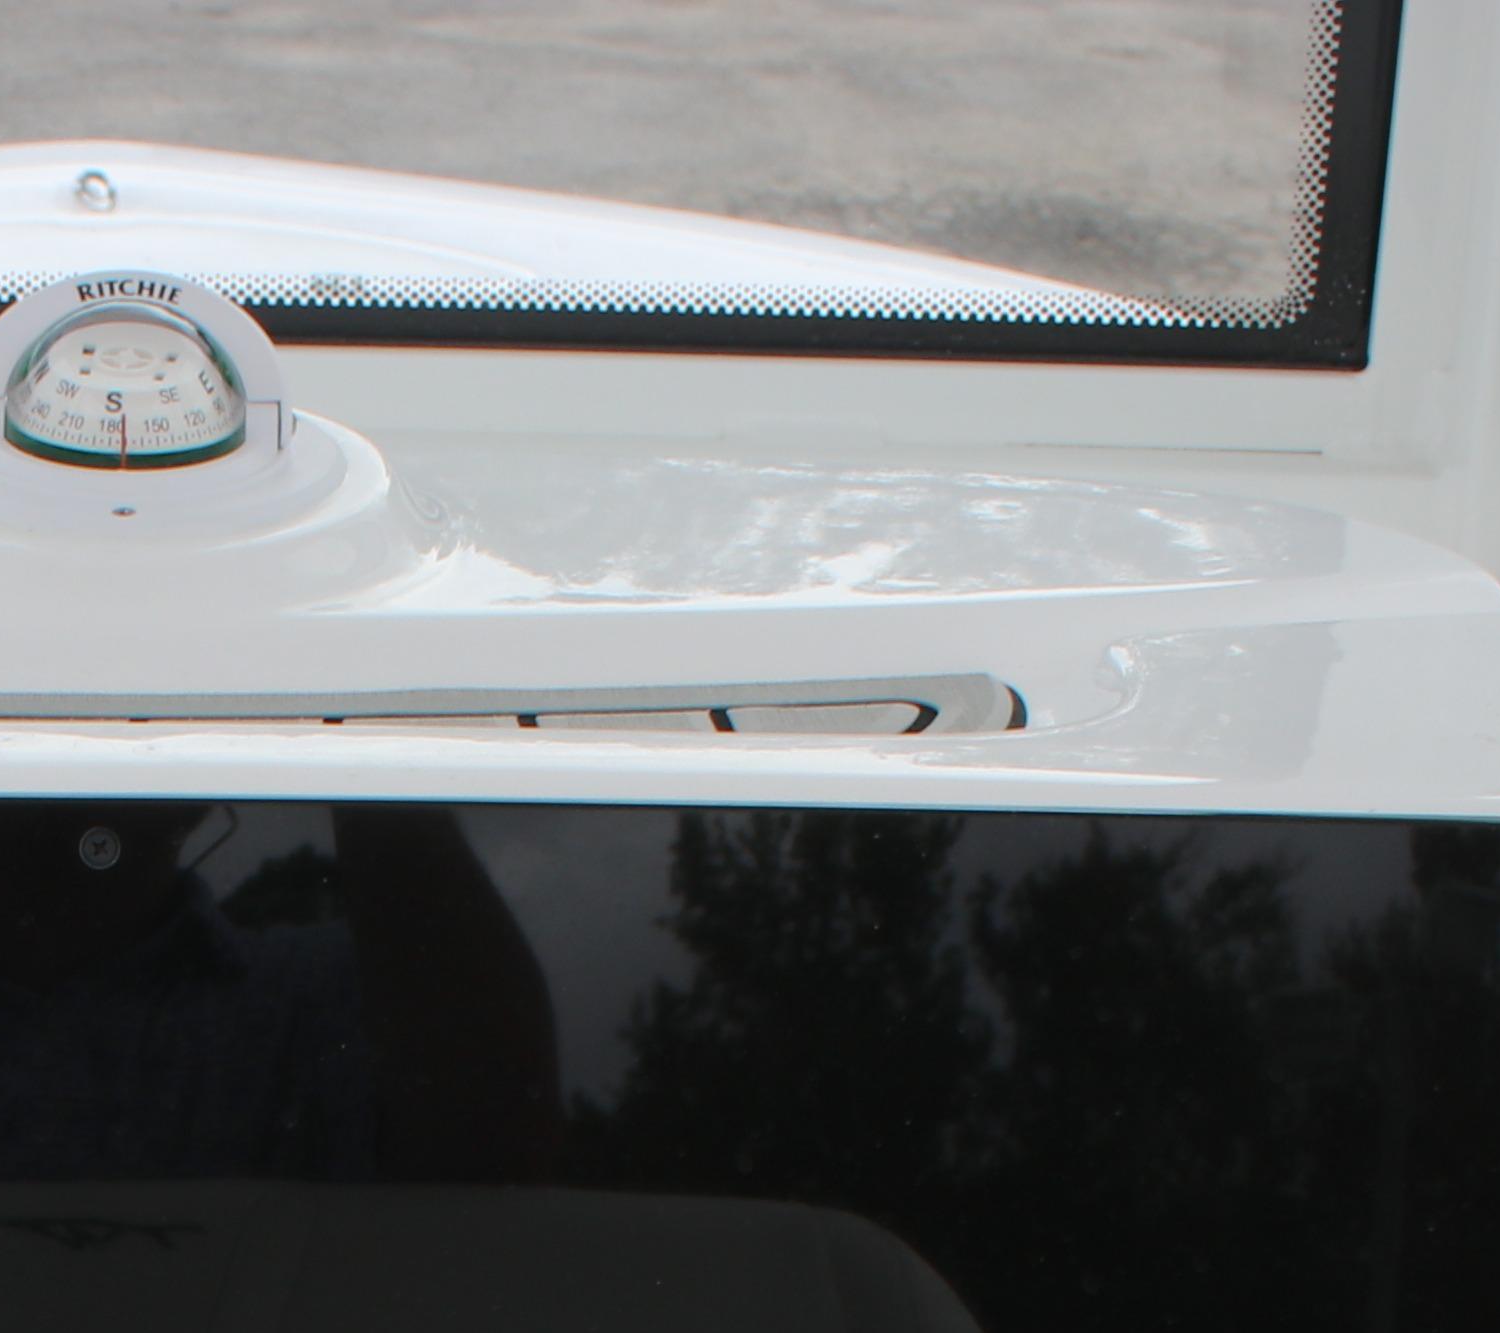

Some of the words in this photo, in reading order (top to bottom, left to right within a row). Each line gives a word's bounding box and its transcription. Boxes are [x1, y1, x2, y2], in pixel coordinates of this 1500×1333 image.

[77, 279, 182, 304] RITCHIE
[199, 369, 214, 394] E
[105, 392, 122, 412] S
[160, 385, 180, 404] SE
[59, 411, 85, 430] 210
[145, 418, 169, 433] 150
